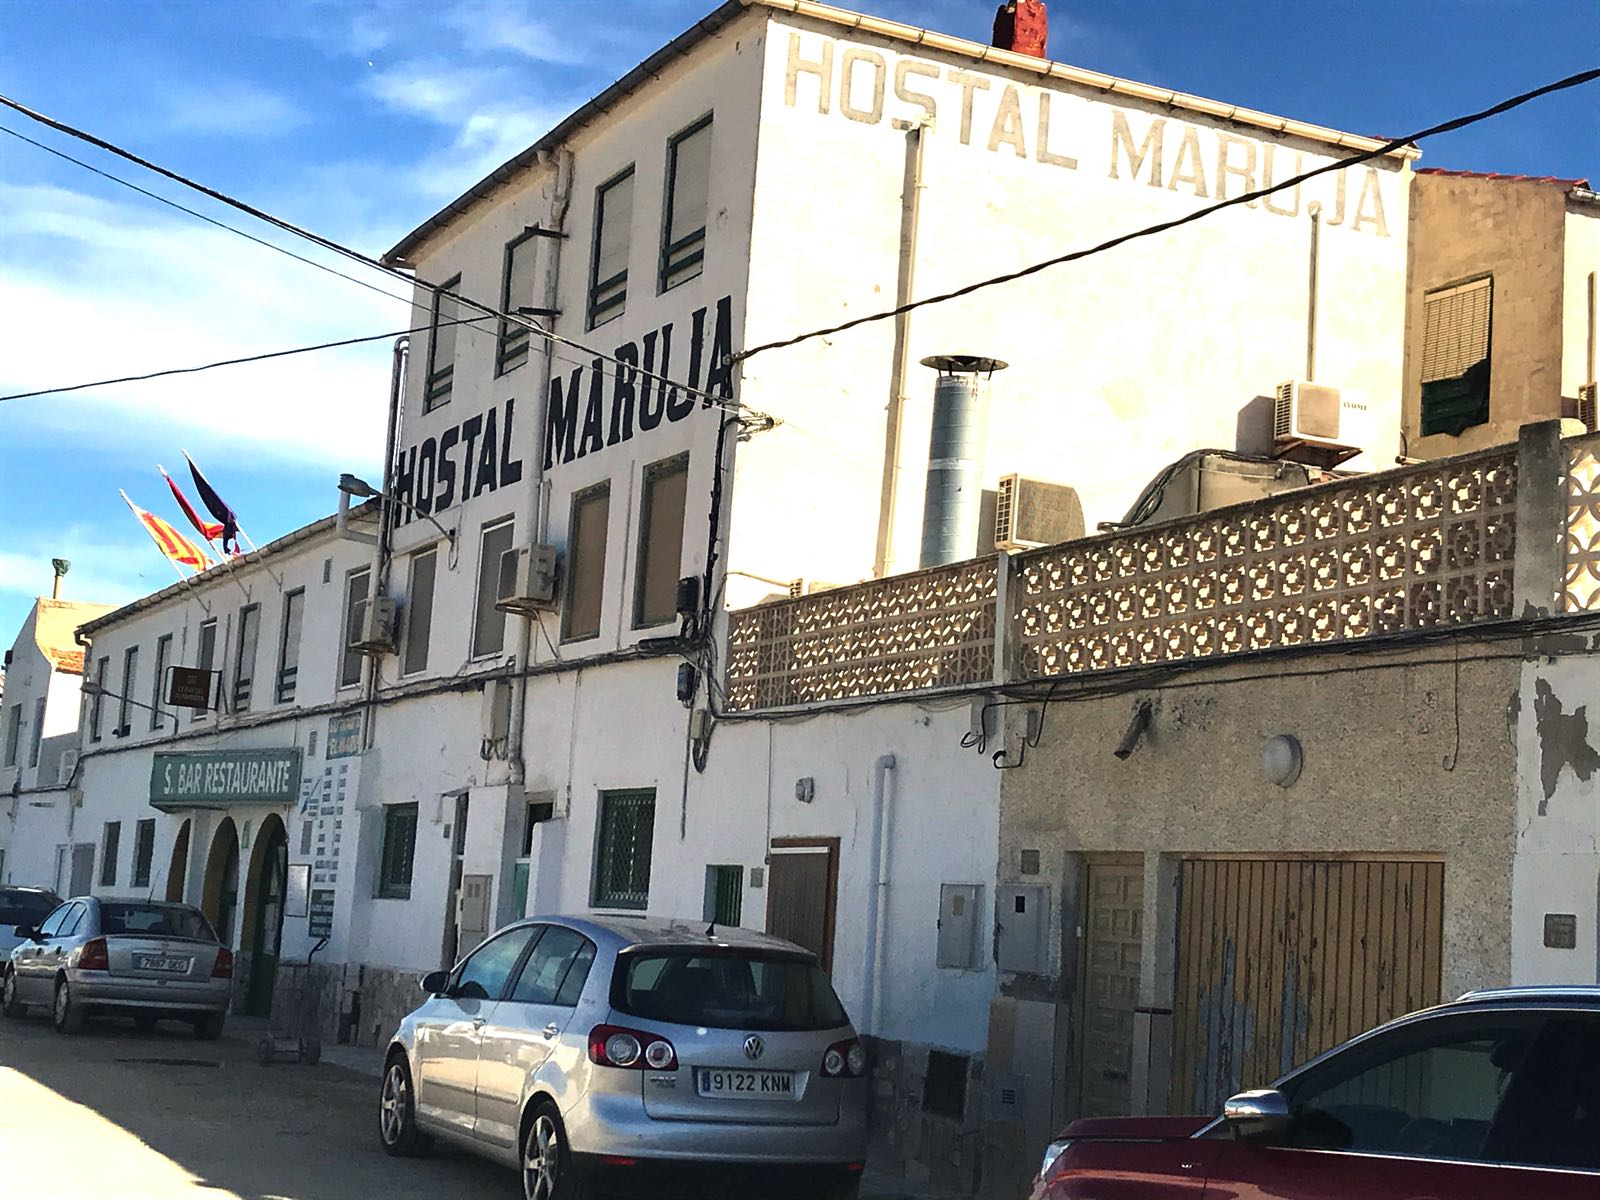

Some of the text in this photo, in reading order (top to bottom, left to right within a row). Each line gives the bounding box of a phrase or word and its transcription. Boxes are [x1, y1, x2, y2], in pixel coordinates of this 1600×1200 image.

[784, 32, 1390, 238] HOSTAL MARUJA
[395, 295, 733, 528] HOSTAL MARUJA
[178, 763, 202, 794] BAR
[205, 761, 291, 794] RESTAURANTE
[713, 1073, 791, 1092] 9122 KNM
